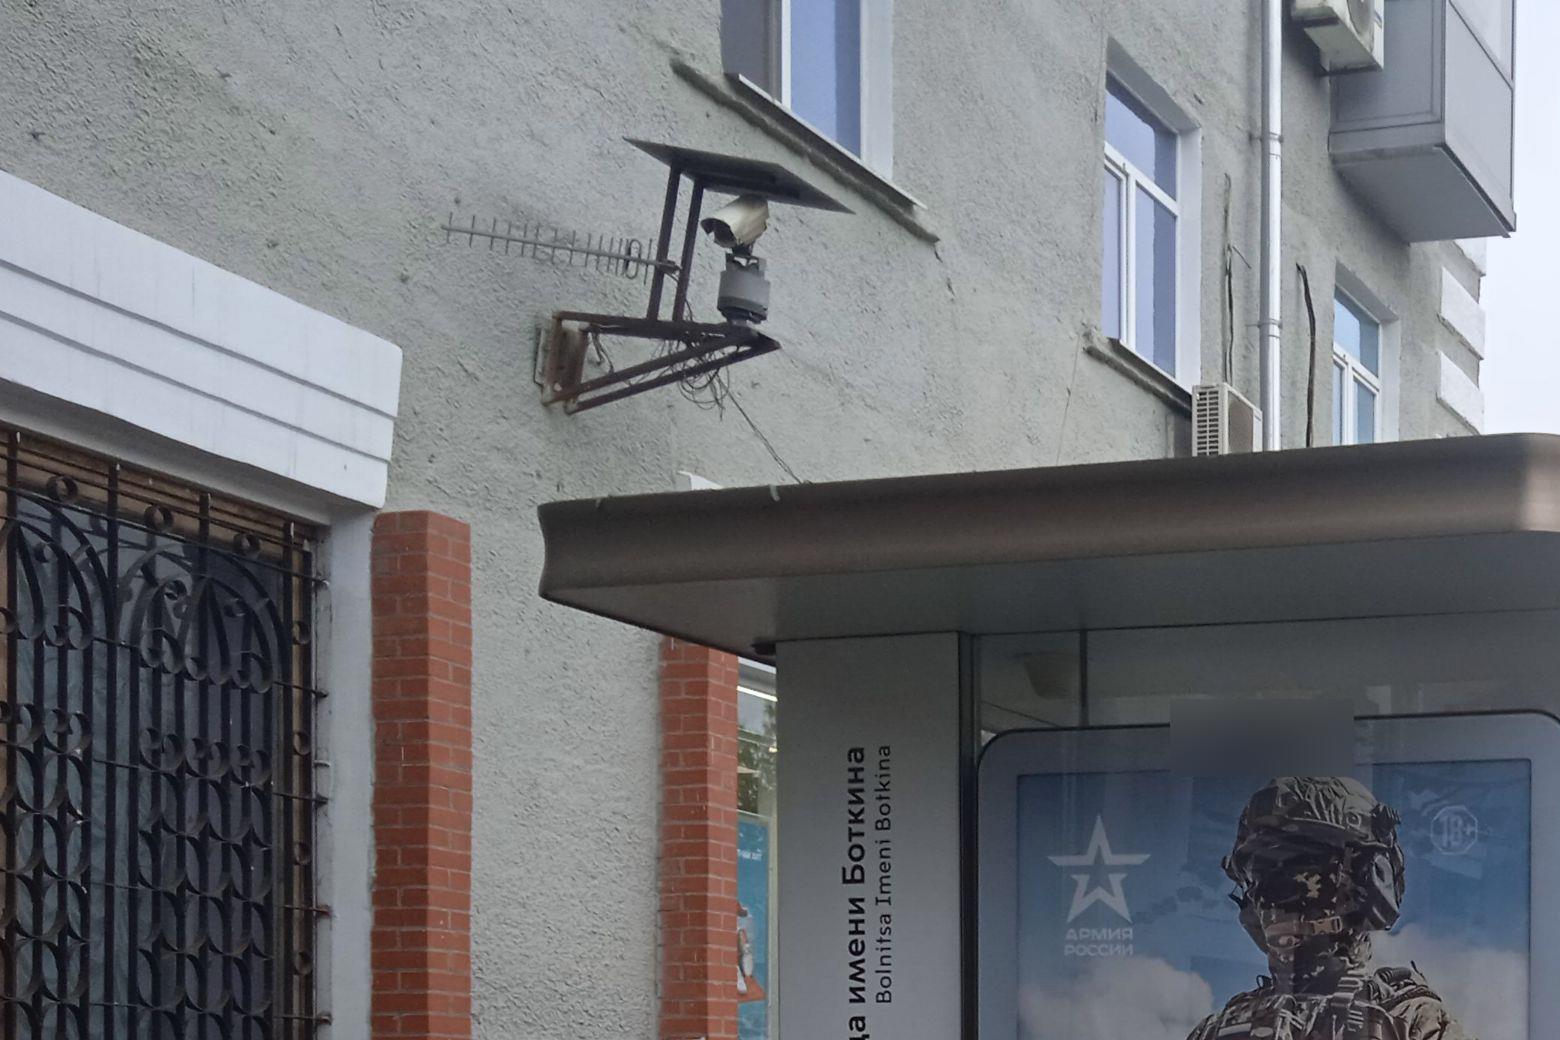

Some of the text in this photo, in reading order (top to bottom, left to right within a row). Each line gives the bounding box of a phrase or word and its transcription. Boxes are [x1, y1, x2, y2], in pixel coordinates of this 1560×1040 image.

[842, 747, 866, 885] Боткина
[1440, 814, 1476, 848] 18+
[873, 745, 892, 1004] Bolnitsa Imeni Botkina
[848, 897, 867, 1004] имени
[1063, 943, 1134, 957] РОССИИ
[1065, 927, 1133, 941] АРМИЯ
